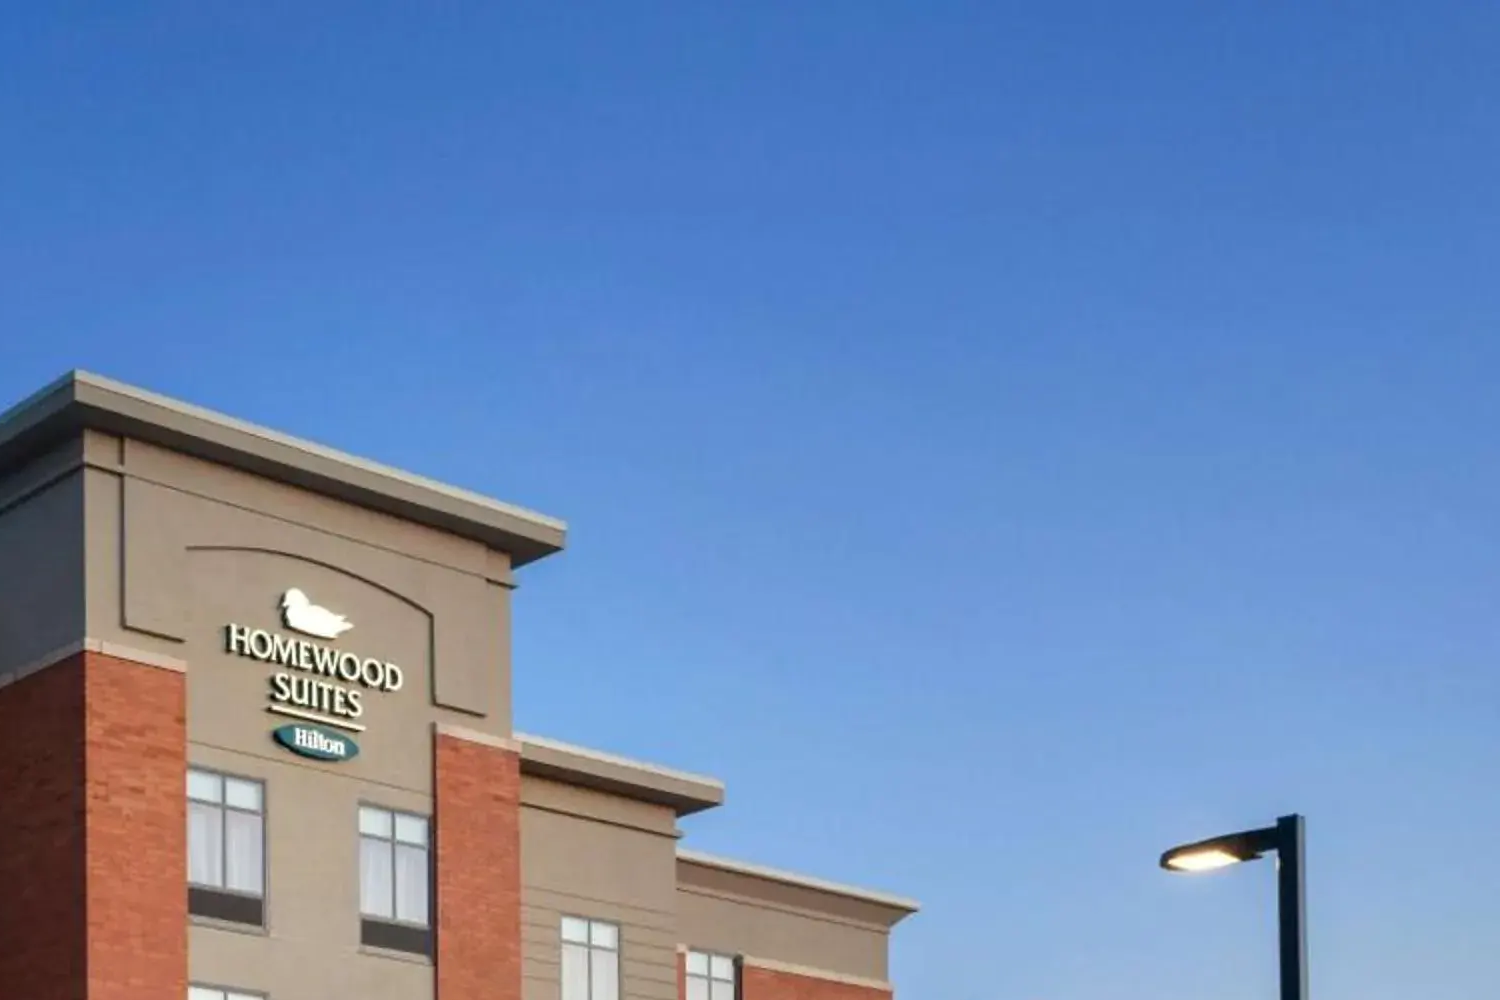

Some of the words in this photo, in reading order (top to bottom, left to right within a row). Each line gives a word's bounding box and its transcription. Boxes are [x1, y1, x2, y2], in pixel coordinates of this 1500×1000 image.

[228, 623, 403, 691] HOMEWOOD
[273, 672, 362, 717] SUITES
[294, 727, 346, 756] Hilton
